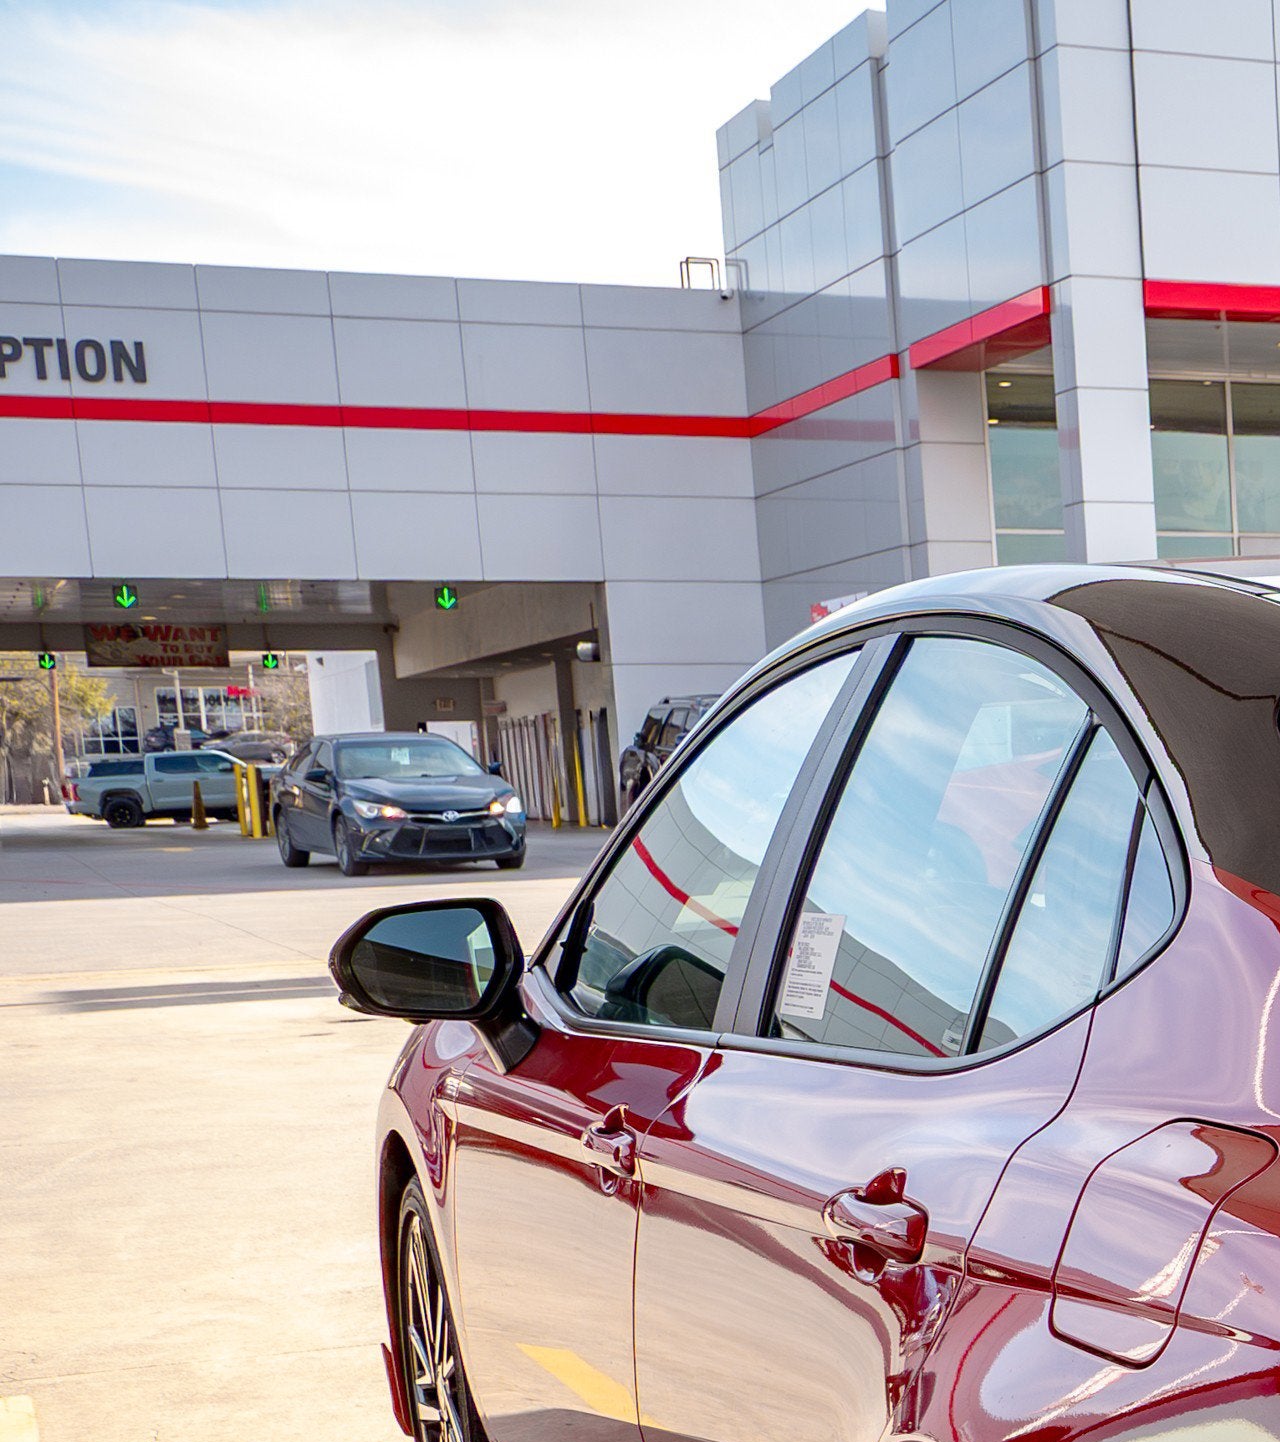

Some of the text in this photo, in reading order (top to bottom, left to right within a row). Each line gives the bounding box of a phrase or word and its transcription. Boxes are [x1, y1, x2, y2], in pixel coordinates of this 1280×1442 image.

[0, 335, 147, 383] PTION
[142, 624, 222, 643] WANT
[160, 643, 180, 654] TO
